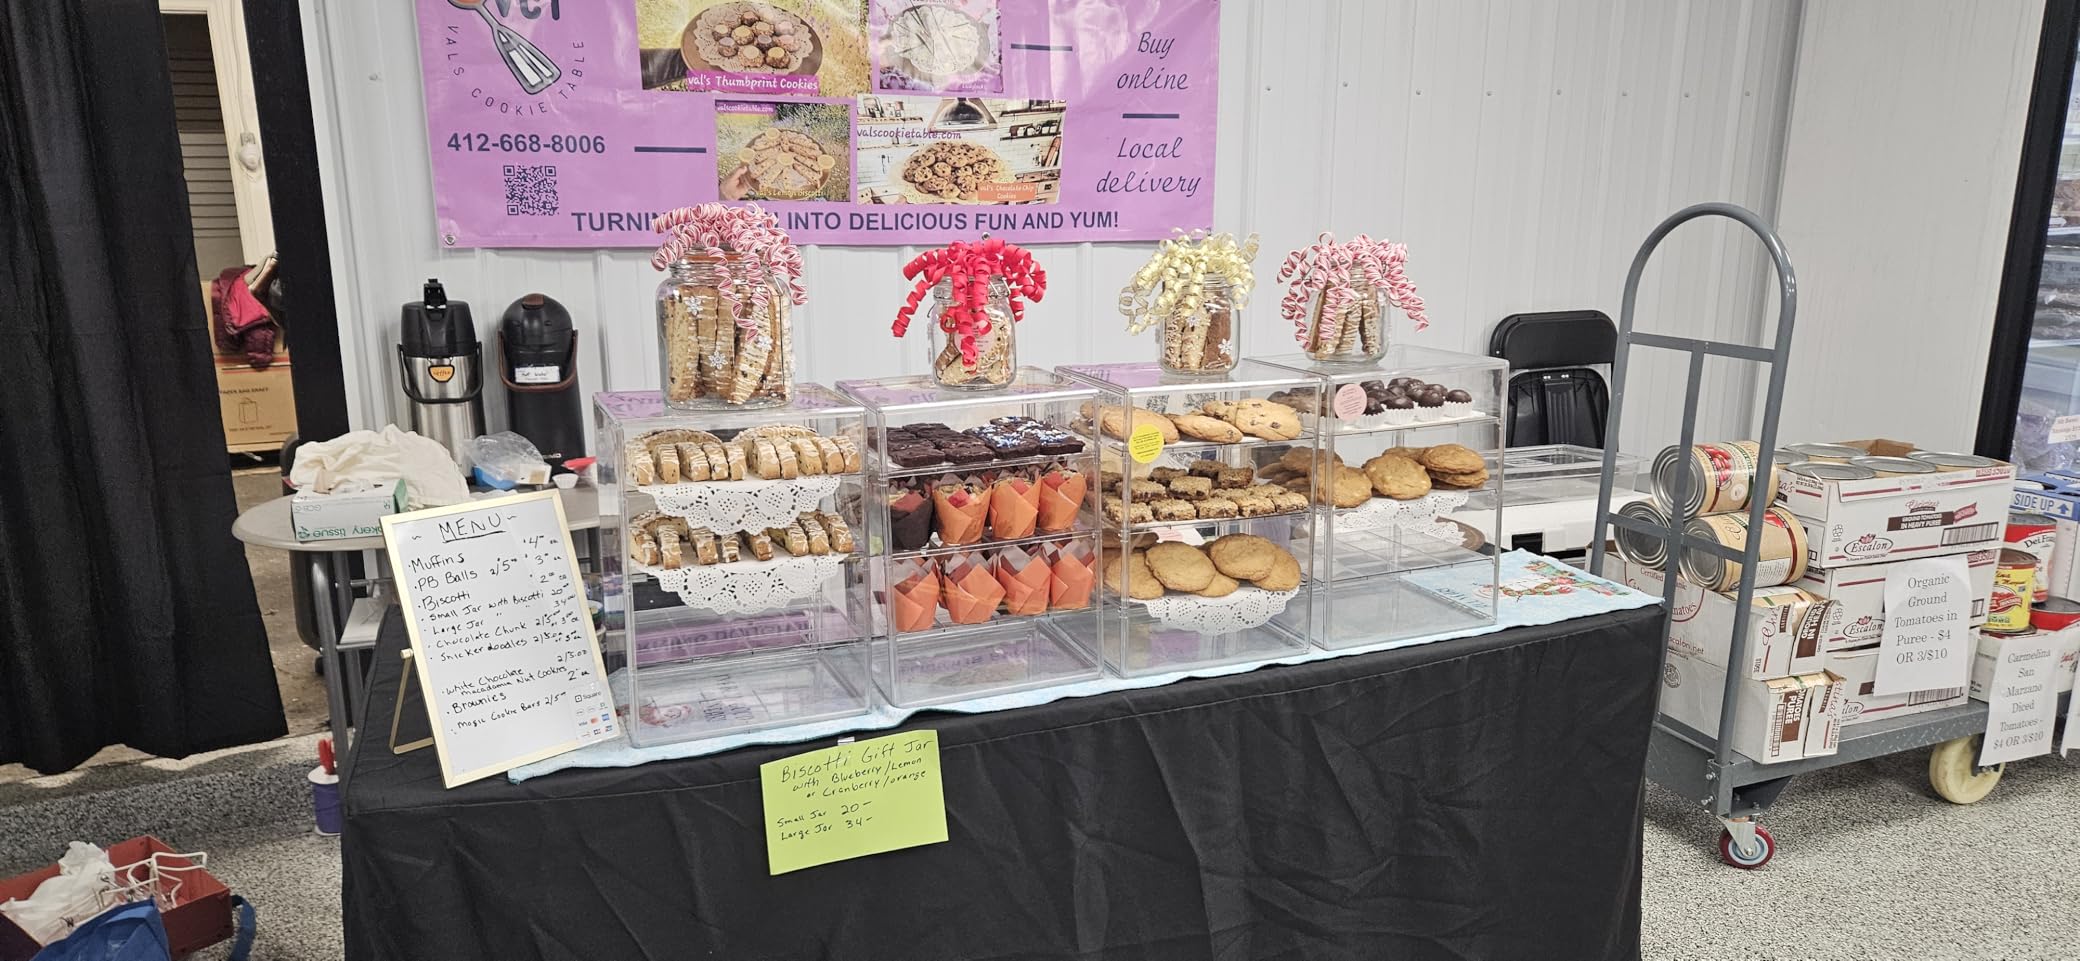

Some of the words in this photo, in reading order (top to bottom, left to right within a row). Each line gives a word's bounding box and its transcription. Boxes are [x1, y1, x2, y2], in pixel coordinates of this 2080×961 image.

[1137, 31, 1175, 60] Buy
[446, 25, 464, 76] VALS
[471, 88, 547, 116] COOKIE
[559, 41, 585, 100] TABLE
[1116, 67, 1188, 90] online
[688, 74, 711, 85] val's
[715, 76, 777, 90] Thumbprint
[780, 79, 818, 90] Cookies
[857, 126, 962, 140] valscookietable.com
[447, 132, 606, 154] 412-668-8006
[1117, 136, 1183, 159] Local
[1096, 170, 1202, 198] delivery
[571, 212, 661, 232] TURNI
[788, 211, 841, 230] INTO
[850, 212, 968, 231] DELICIOUS
[975, 213, 1018, 230] FUN
[1022, 211, 1065, 229] AND
[1070, 211, 1120, 228] YUM!
[2014, 493, 2038, 508] SIDE
[2040, 498, 2055, 511] UP
[313, 528, 346, 538] tissue
[352, 524, 383, 535] akery
[439, 513, 501, 541] MENU
[1851, 541, 1888, 553] Escalon
[411, 553, 465, 573] Muffins
[417, 576, 439, 591] PB
[445, 570, 478, 584] Balls
[1640, 567, 1664, 581] Certified
[1908, 573, 1950, 589] Organic
[422, 591, 470, 611] Biscotti
[429, 609, 458, 621] Small
[462, 604, 482, 615] Jar
[489, 597, 508, 608] with
[513, 590, 544, 605] Biscotti
[1908, 592, 1947, 608] Ground
[433, 623, 461, 636] Large
[466, 619, 484, 630] Jar
[1850, 621, 1883, 635] Escalon
[1894, 613, 1944, 628] Tomatoes
[1946, 610, 1958, 621] in
[436, 631, 490, 648] Chocolate
[495, 622, 527, 637] Chunk
[1896, 634, 1927, 646] Puree
[1937, 629, 1951, 641] $4
[1896, 651, 1914, 664] OR
[1917, 648, 1948, 662] 3/$10
[2007, 648, 2051, 663] Carmelina
[478, 667, 524, 685] Chocolate
[516, 674, 536, 685] Nut
[537, 665, 568, 679] Cookies
[2018, 667, 2035, 678] San
[2006, 683, 2043, 697] Marzano
[452, 692, 507, 714] Brownies
[490, 709, 517, 721] Cookie
[520, 701, 541, 712] Bars
[1785, 695, 1797, 725] PUREE
[2011, 700, 2035, 714] Diced
[2000, 718, 2038, 732] Tomatoes
[2006, 736, 2020, 747] OR
[782, 750, 852, 783] Biscotti
[861, 742, 895, 763] Gift
[904, 739, 934, 753] Jar
[793, 778, 819, 792] with
[777, 815, 804, 828] Small
[810, 809, 827, 820] Jar
[781, 829, 810, 840] Large
[815, 823, 833, 834] Jar
